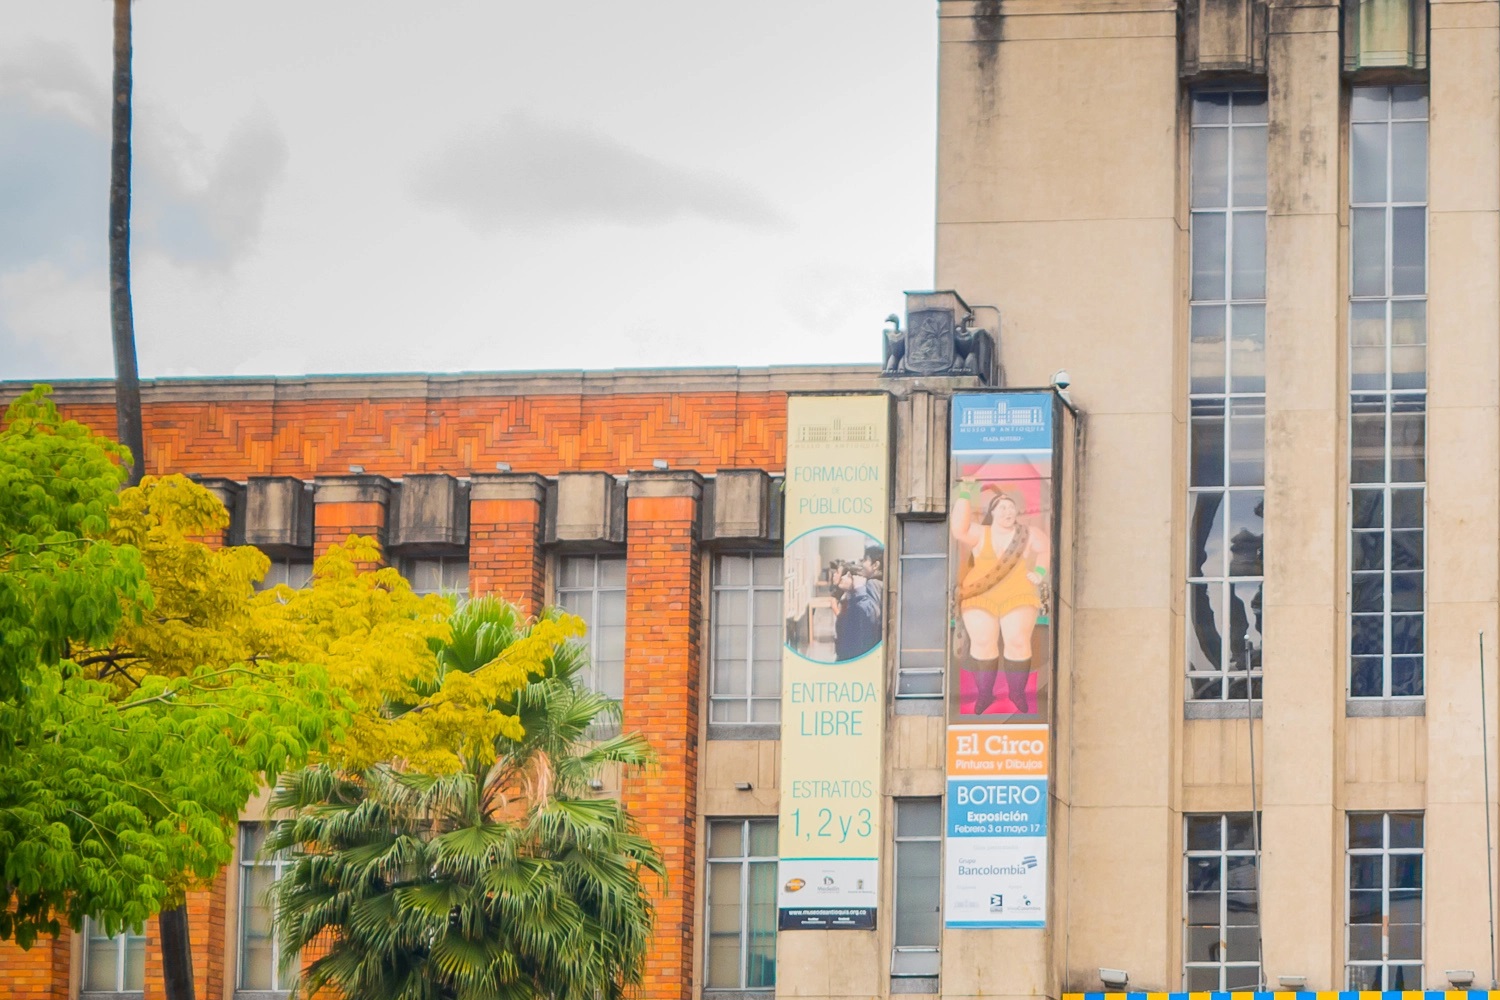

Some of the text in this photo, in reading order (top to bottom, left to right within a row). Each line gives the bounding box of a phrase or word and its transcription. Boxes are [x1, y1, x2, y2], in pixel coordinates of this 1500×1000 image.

[794, 461, 879, 482] FORMACIÓN
[799, 494, 873, 514] PÚBLICOS
[791, 682, 877, 703] ENTRADA
[801, 710, 863, 736] LIBRE
[956, 733, 1044, 755] El Circo
[956, 759, 994, 770] Pinturas
[1005, 759, 1043, 771] Dibujos
[792, 780, 872, 798] ESTRATOS
[957, 785, 1040, 805] BOTERO
[967, 811, 1028, 823] Exposición
[955, 825, 986, 833] Febrero
[1002, 826, 1027, 835] mayo
[1029, 824, 1040, 833] 17
[958, 865, 1026, 875] Bancolombia
